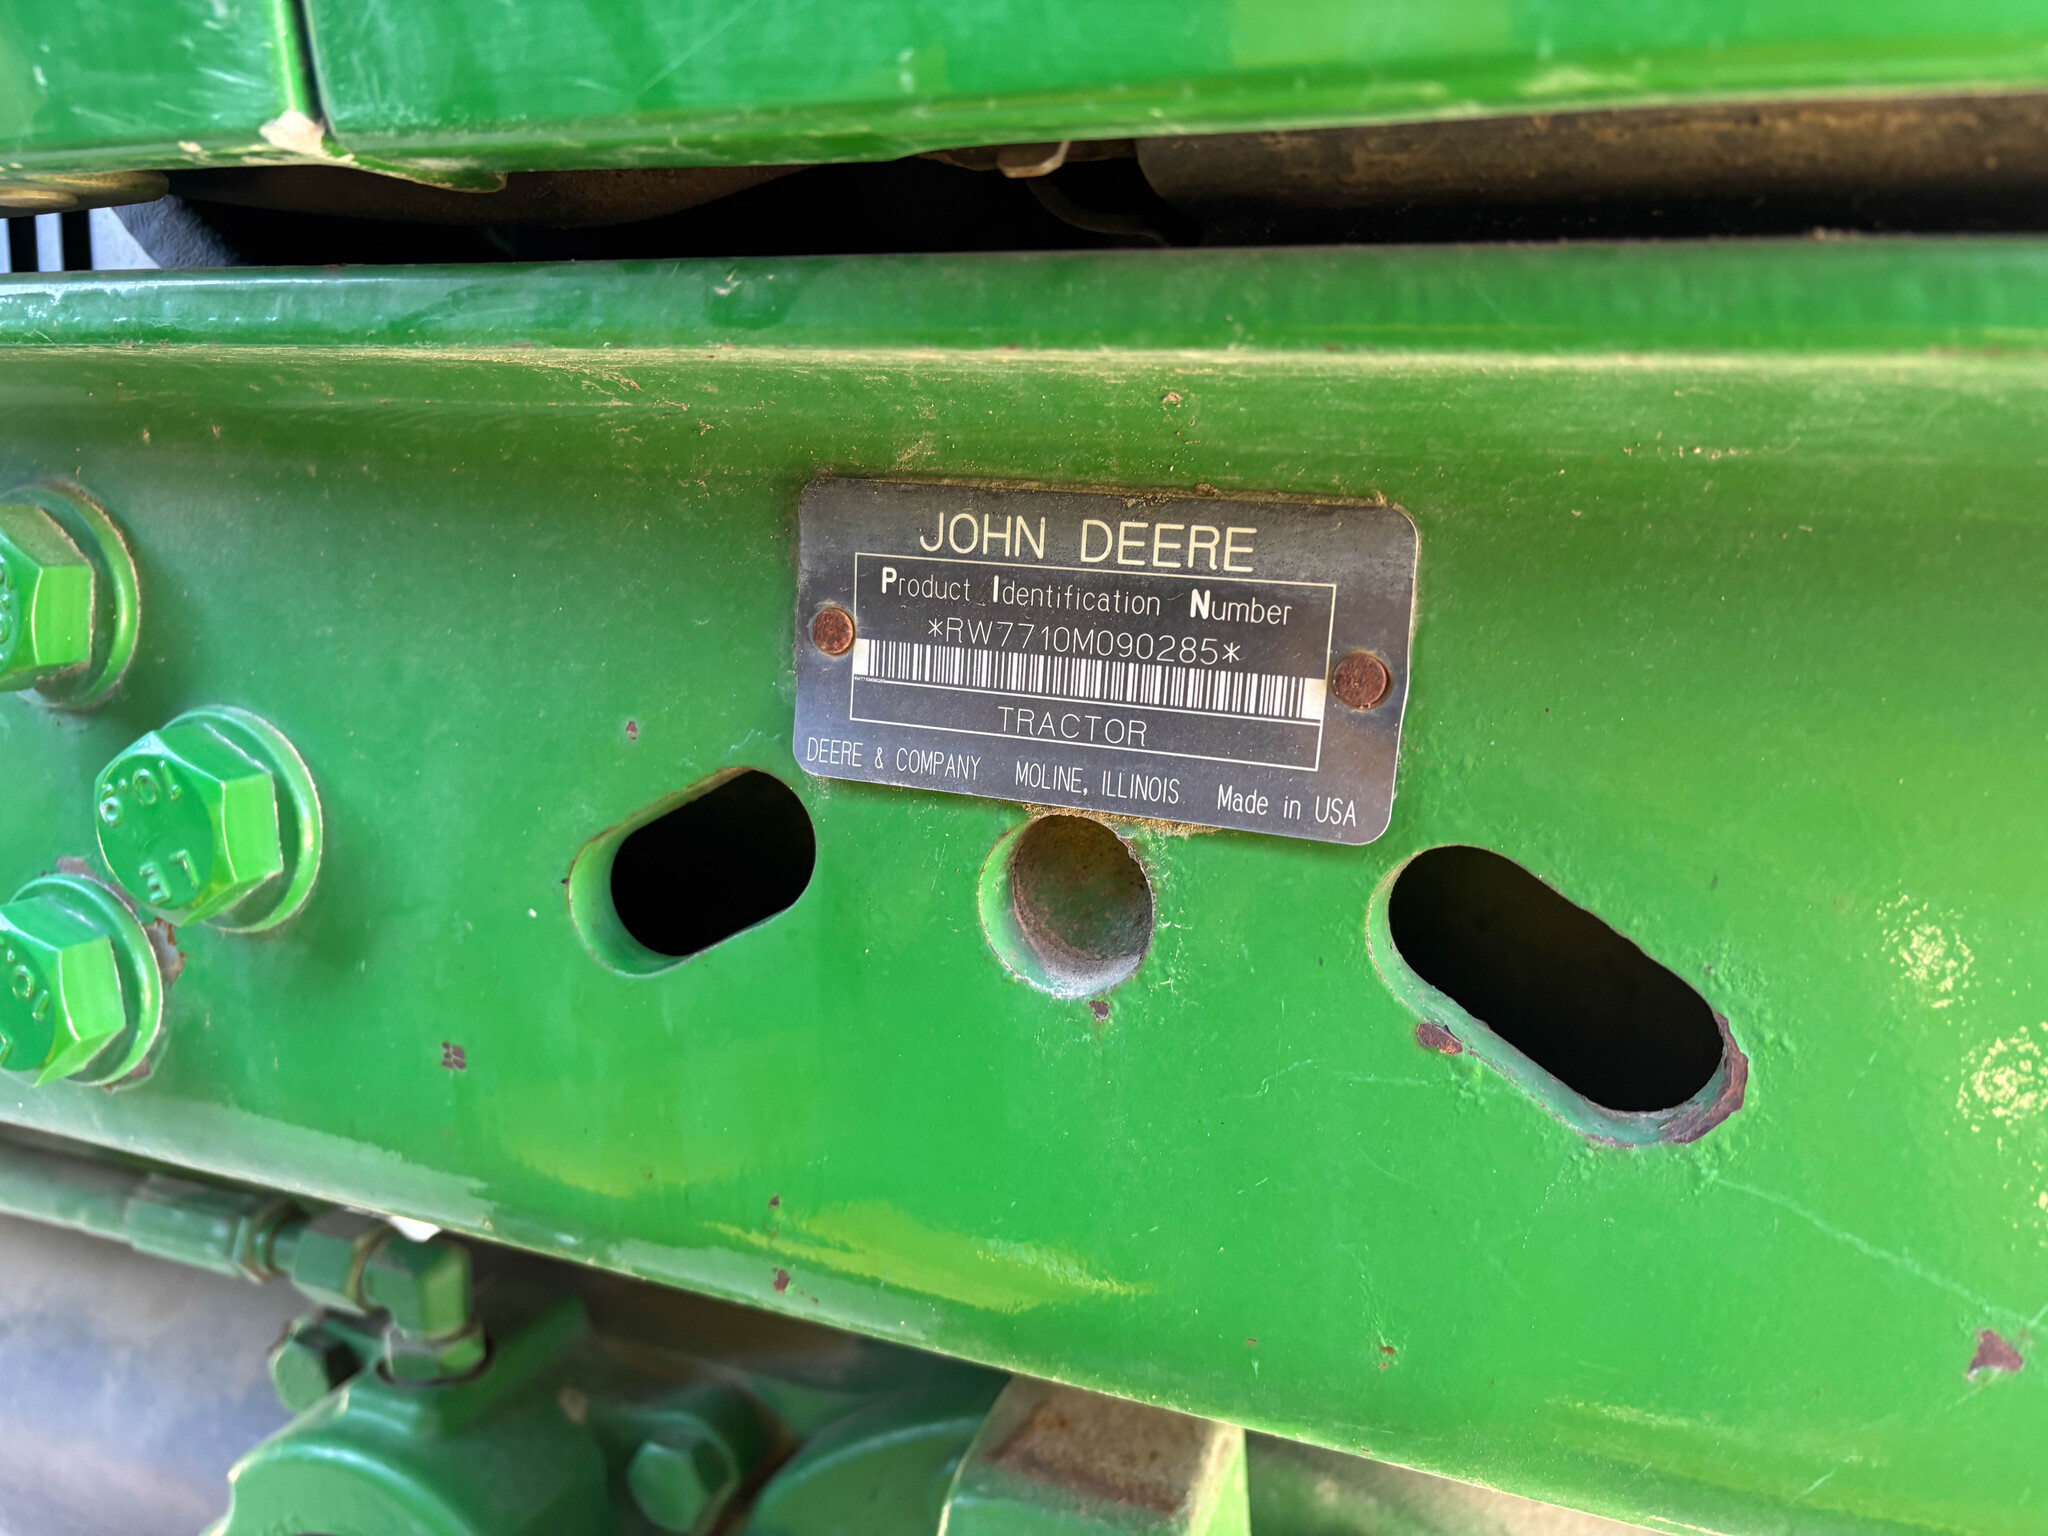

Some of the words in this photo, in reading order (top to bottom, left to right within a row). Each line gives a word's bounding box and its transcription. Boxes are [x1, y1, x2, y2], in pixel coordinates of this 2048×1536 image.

[919, 511, 1046, 560] JOHN
[1080, 519, 1258, 573] DEERE
[881, 566, 971, 602] Product
[992, 574, 1161, 617] Identification
[1190, 588, 1293, 626] Number
[997, 706, 1148, 747] TRACTOR
[806, 736, 864, 768] DEERE
[874, 746, 885, 770] &
[896, 747, 982, 781] COMPANY
[1014, 760, 1088, 796] MOLINE,
[1100, 770, 1181, 805] ILLINOIS
[1216, 783, 1269, 816] Made
[1282, 795, 1301, 820] in
[1314, 795, 1357, 828] USA
